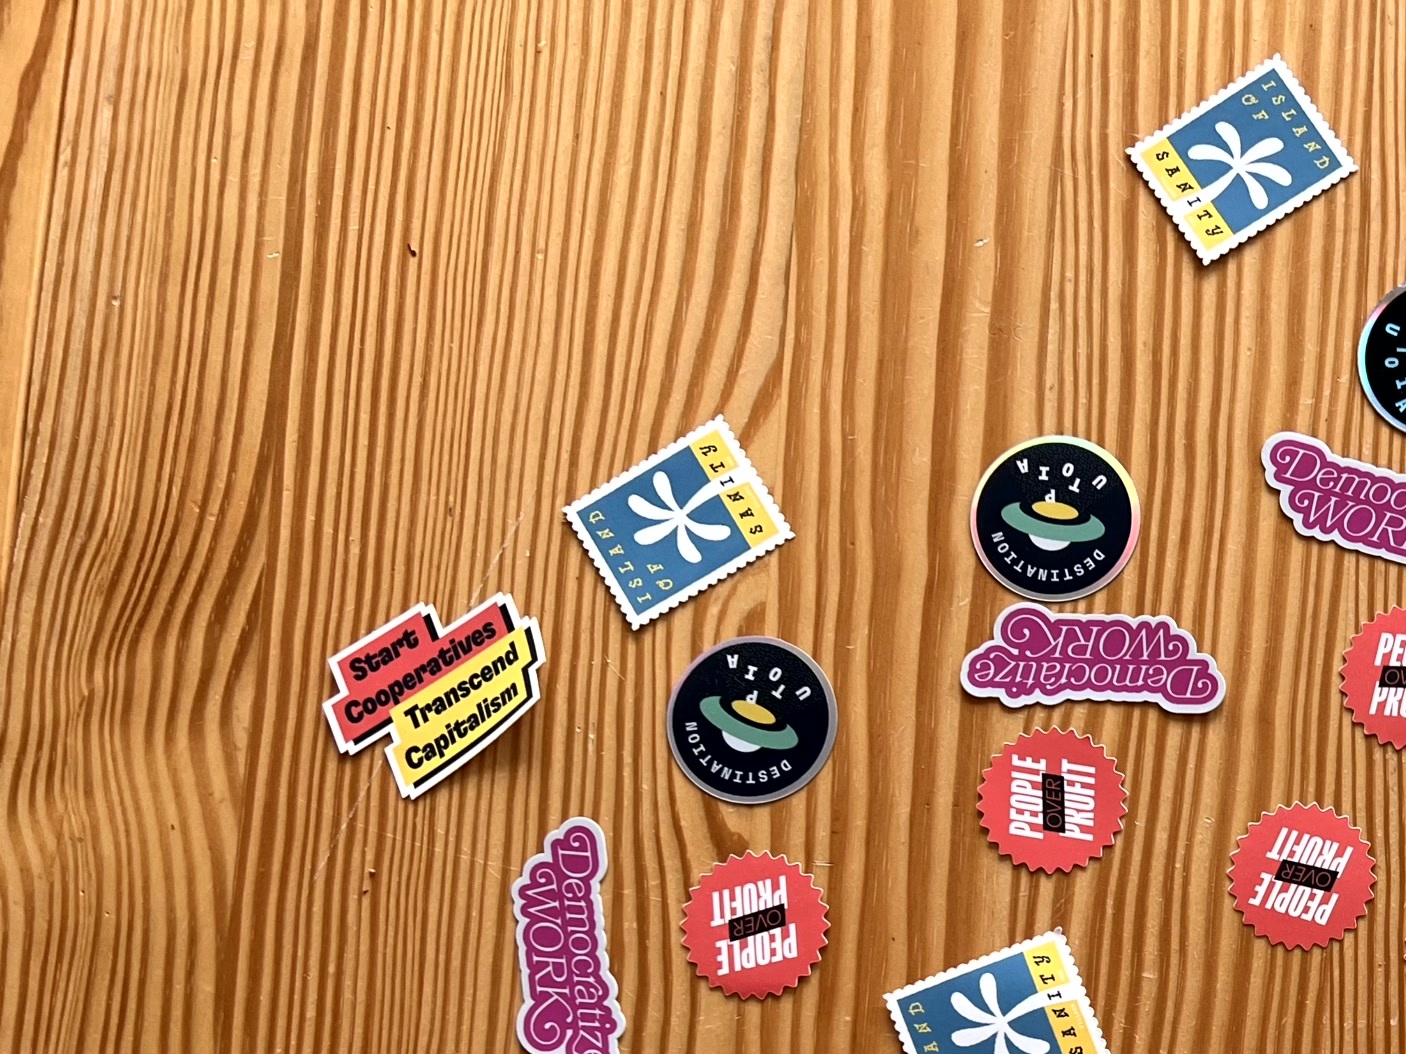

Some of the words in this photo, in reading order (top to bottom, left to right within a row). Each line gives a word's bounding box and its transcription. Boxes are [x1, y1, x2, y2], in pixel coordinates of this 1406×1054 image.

[1241, 93, 1270, 120] OF
[1261, 79, 1330, 169] ISLAND
[1155, 150, 1224, 236] SANITY
[699, 444, 764, 536] SANITY
[1015, 457, 1108, 505] UTOPIA
[588, 510, 653, 604] ISLAND
[646, 563, 674, 591] OF
[991, 531, 1106, 582] DESTINATION
[348, 628, 420, 682] Start
[1008, 614, 1183, 660] WORK
[343, 620, 497, 725] Cooperatives
[402, 640, 522, 730] Transcend
[725, 653, 812, 707] UTOPIA
[974, 651, 1213, 701] Democratize
[403, 684, 525, 769] Capitalism
[684, 721, 792, 785] DESTINATION
[1008, 752, 1048, 840] PEOPLE
[1044, 777, 1063, 829] OVER
[1247, 870, 1340, 926] PEOPLE
[1279, 862, 1332, 888] OVER
[714, 921, 799, 977] PEOPLE
[731, 909, 783, 938] OVER
[524, 867, 573, 1044] WORK
